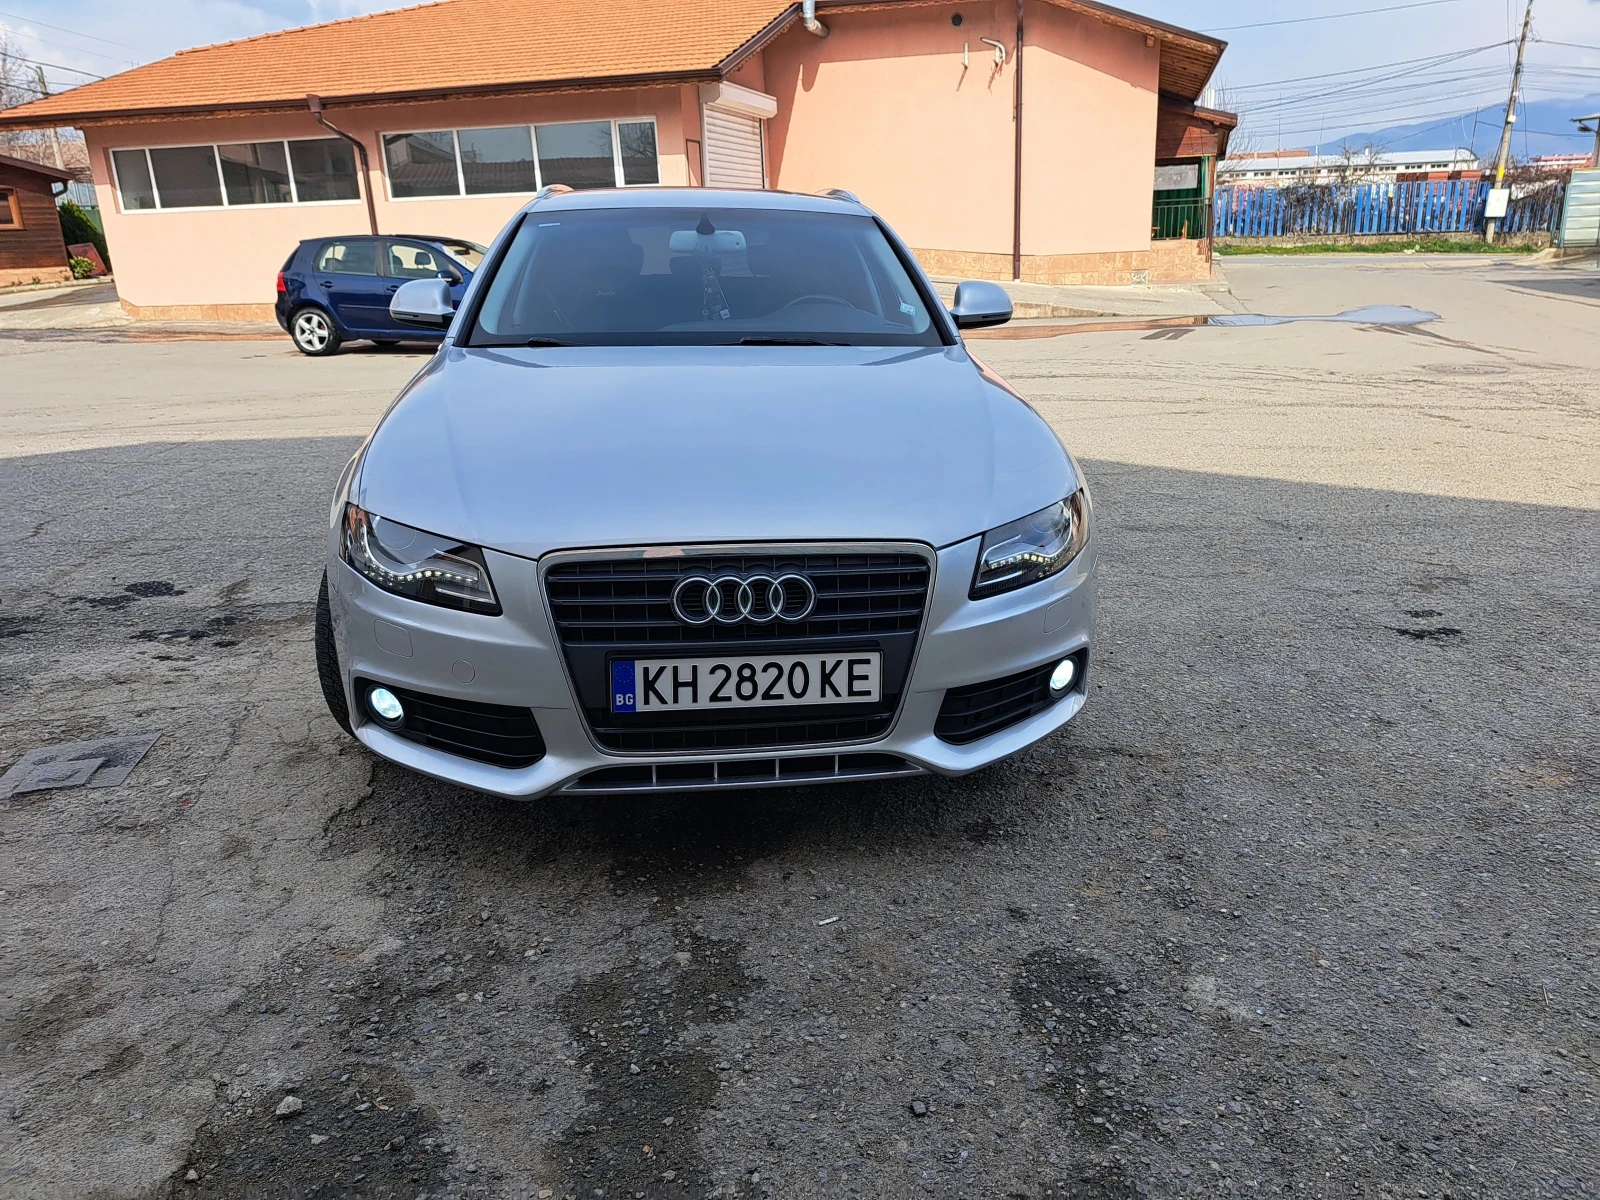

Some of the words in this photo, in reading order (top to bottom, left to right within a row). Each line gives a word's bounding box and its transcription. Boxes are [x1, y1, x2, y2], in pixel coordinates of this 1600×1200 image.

[643, 665, 698, 705] KH
[709, 661, 810, 702] 2820
[820, 658, 871, 698] KE
[615, 694, 634, 706] BG
